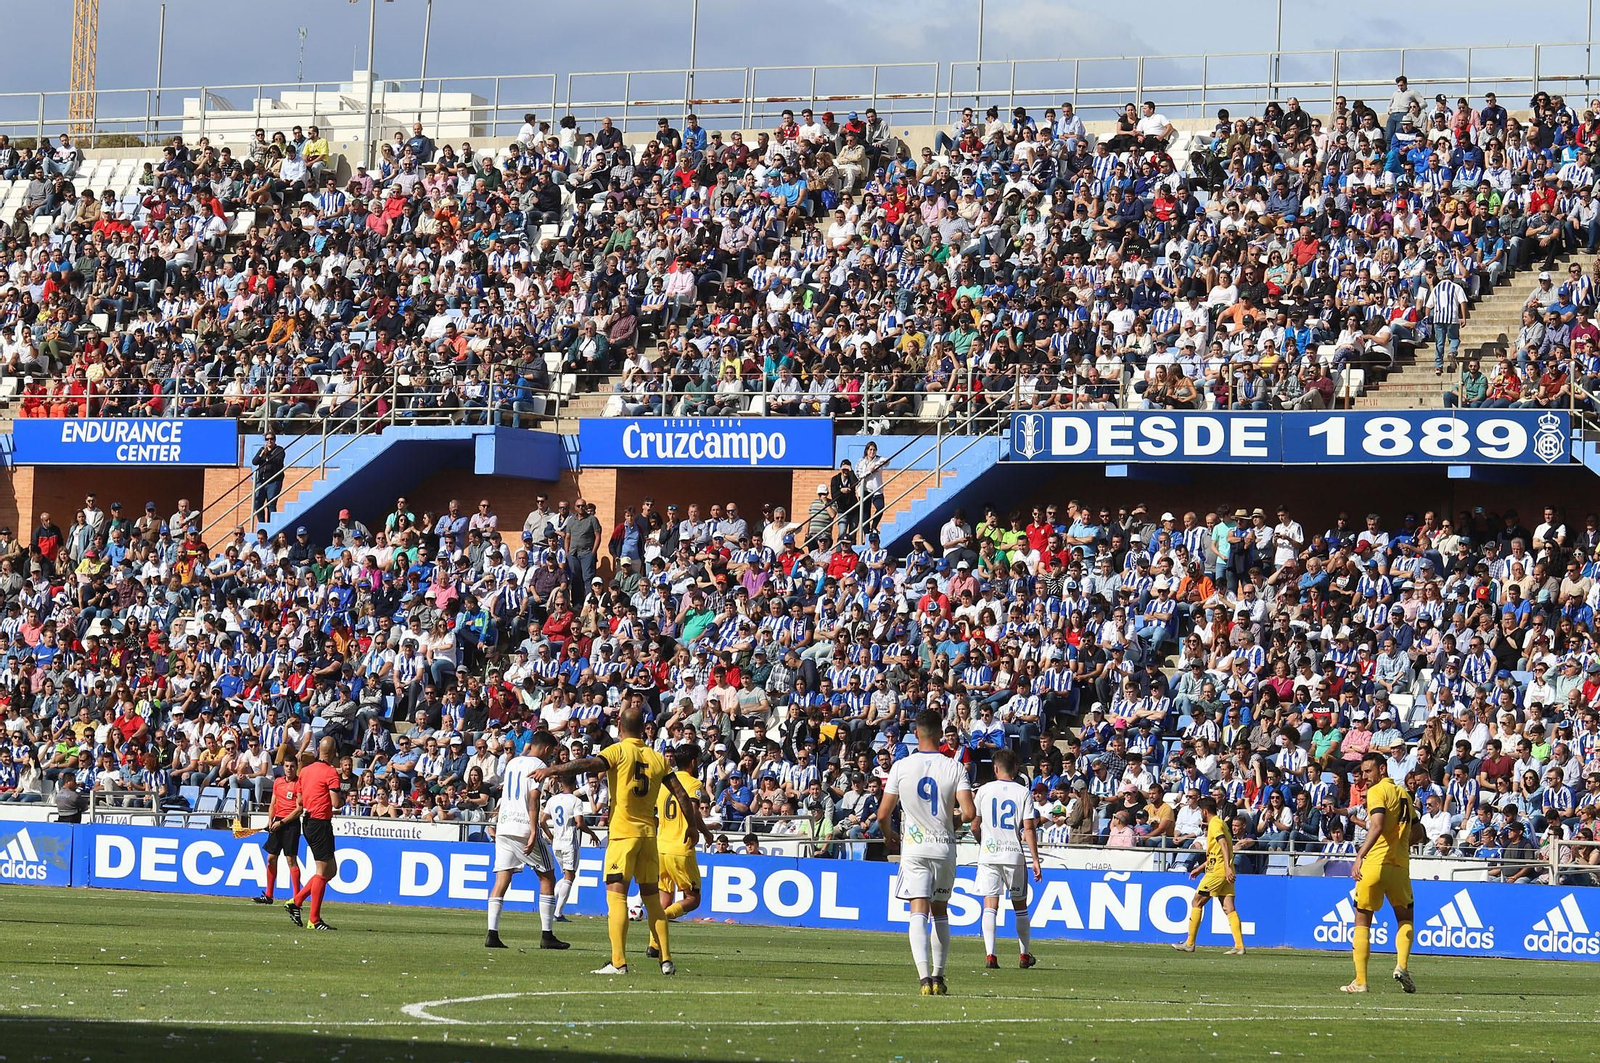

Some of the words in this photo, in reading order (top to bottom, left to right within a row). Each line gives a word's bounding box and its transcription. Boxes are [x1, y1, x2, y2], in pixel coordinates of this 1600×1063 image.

[61, 421, 183, 443] ENDURANCE
[663, 419, 700, 427] DESDE
[622, 422, 787, 465] Cruzcampo
[1051, 416, 1268, 457] DESDE
[1308, 416, 1528, 459] 1889
[116, 444, 181, 462] CENTER
[508, 771, 522, 801] 11
[633, 761, 650, 798] 5
[664, 795, 678, 821] 6
[917, 777, 938, 817] 9
[554, 806, 565, 827] 3
[991, 797, 1017, 830] 12
[343, 822, 422, 840] Restaurante
[0, 860, 48, 880] didas
[563, 858, 859, 921] FBOL
[1417, 925, 1494, 949] adidas
[1524, 930, 1600, 955] adidas
